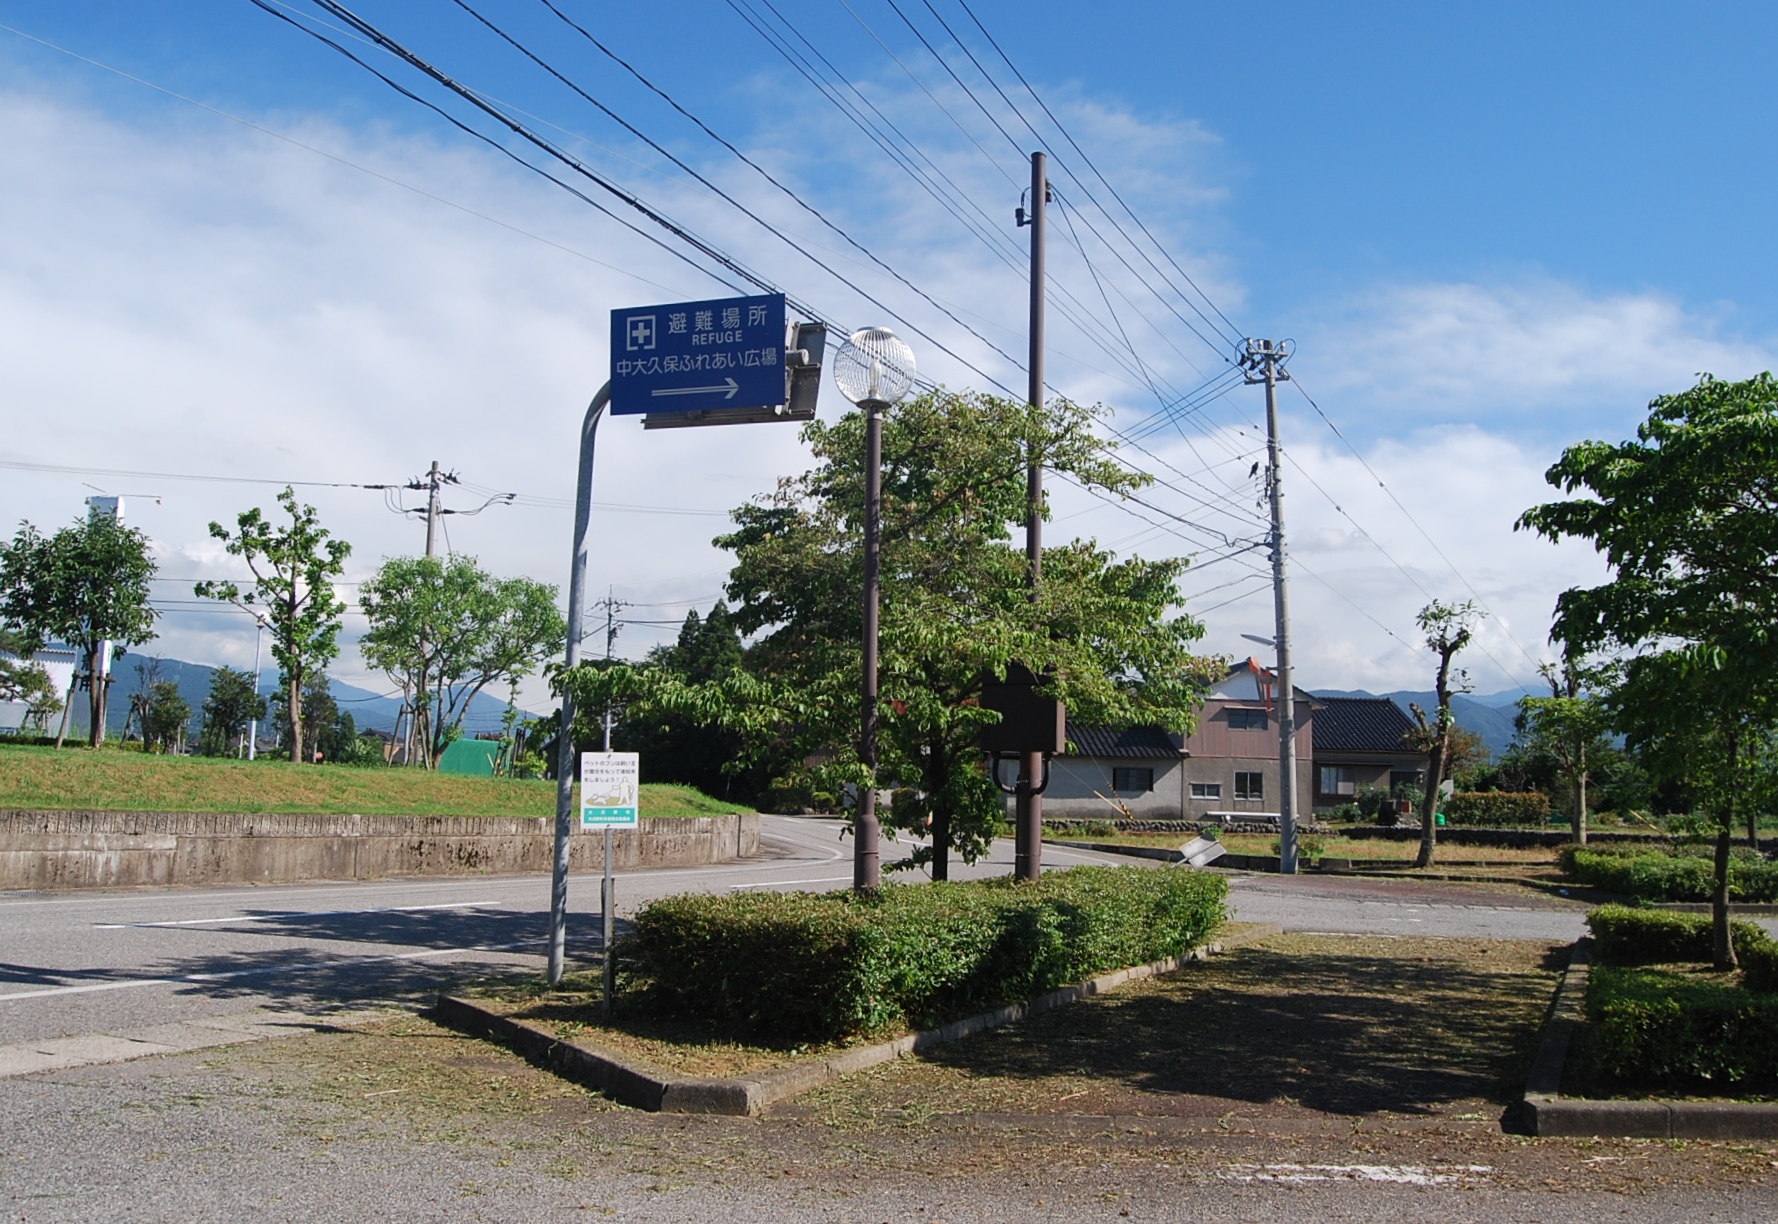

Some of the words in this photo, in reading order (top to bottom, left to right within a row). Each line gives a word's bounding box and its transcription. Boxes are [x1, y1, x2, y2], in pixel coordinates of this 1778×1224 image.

[668, 305, 767, 334] 避難場所
[692, 330, 743, 346] REFUGE
[617, 347, 777, 377] 中大久保ふれあい広場
